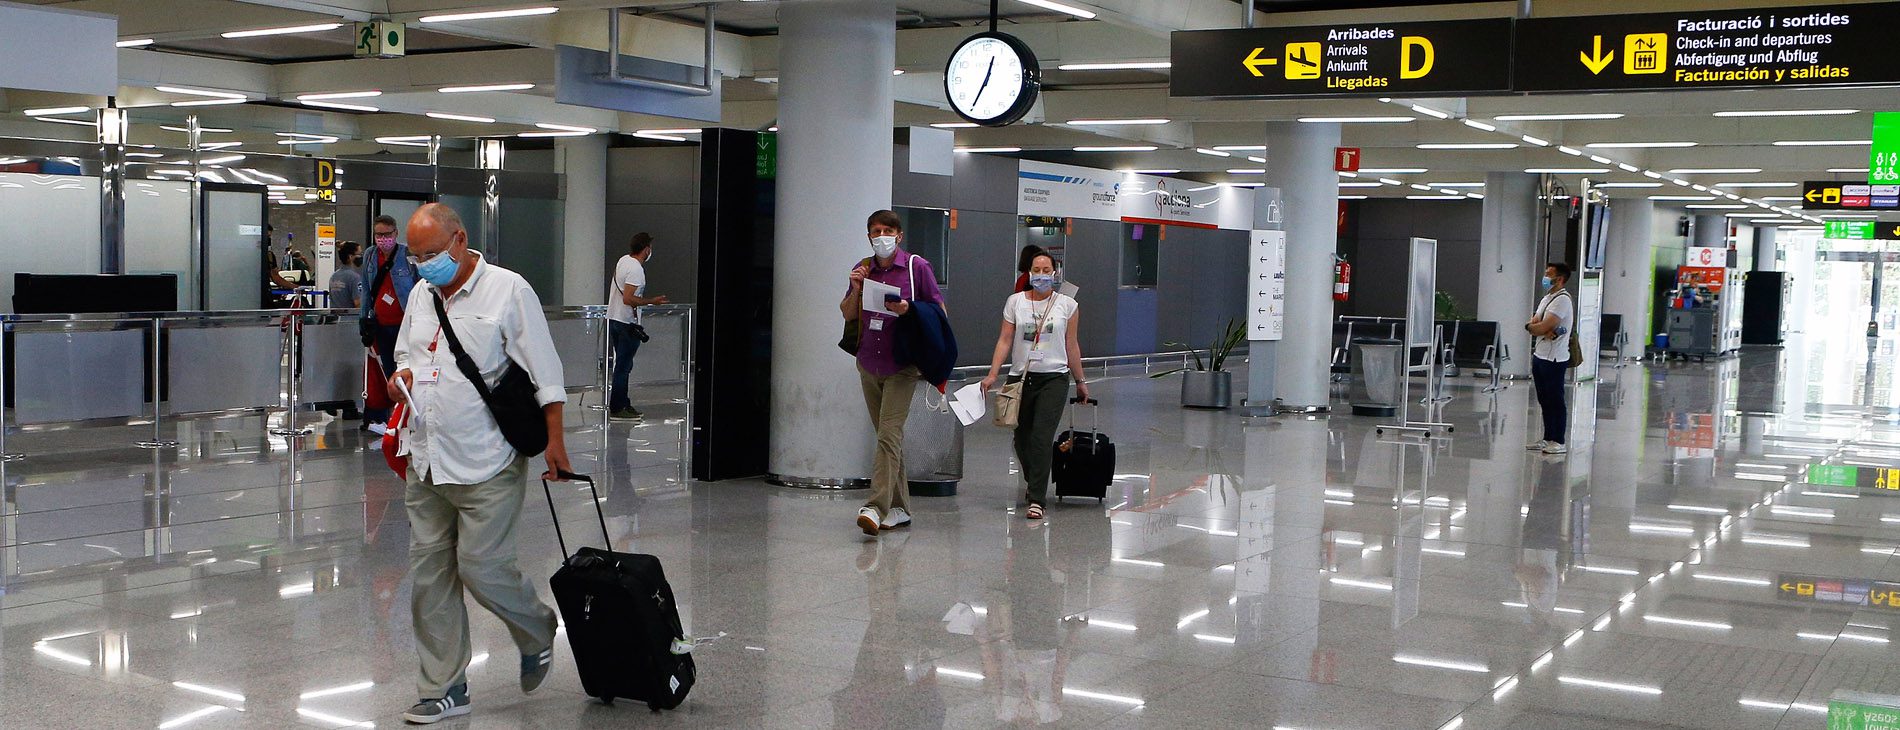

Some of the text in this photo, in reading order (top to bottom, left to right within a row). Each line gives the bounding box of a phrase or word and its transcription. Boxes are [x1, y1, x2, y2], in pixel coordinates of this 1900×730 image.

[1677, 12, 1850, 32] Facturació i sortides
[1327, 26, 1395, 41] Arribades
[1676, 32, 1833, 50] Check-in and departures
[1326, 43, 1368, 57] Arrivals
[1399, 35, 1435, 80] D
[1674, 48, 1819, 68] Abfertigung und Abflug
[1326, 58, 1369, 73] Ankunft
[1675, 64, 1850, 82] Facturación y salidas
[1326, 75, 1389, 91] Llegadas
[318, 160, 334, 187] D
